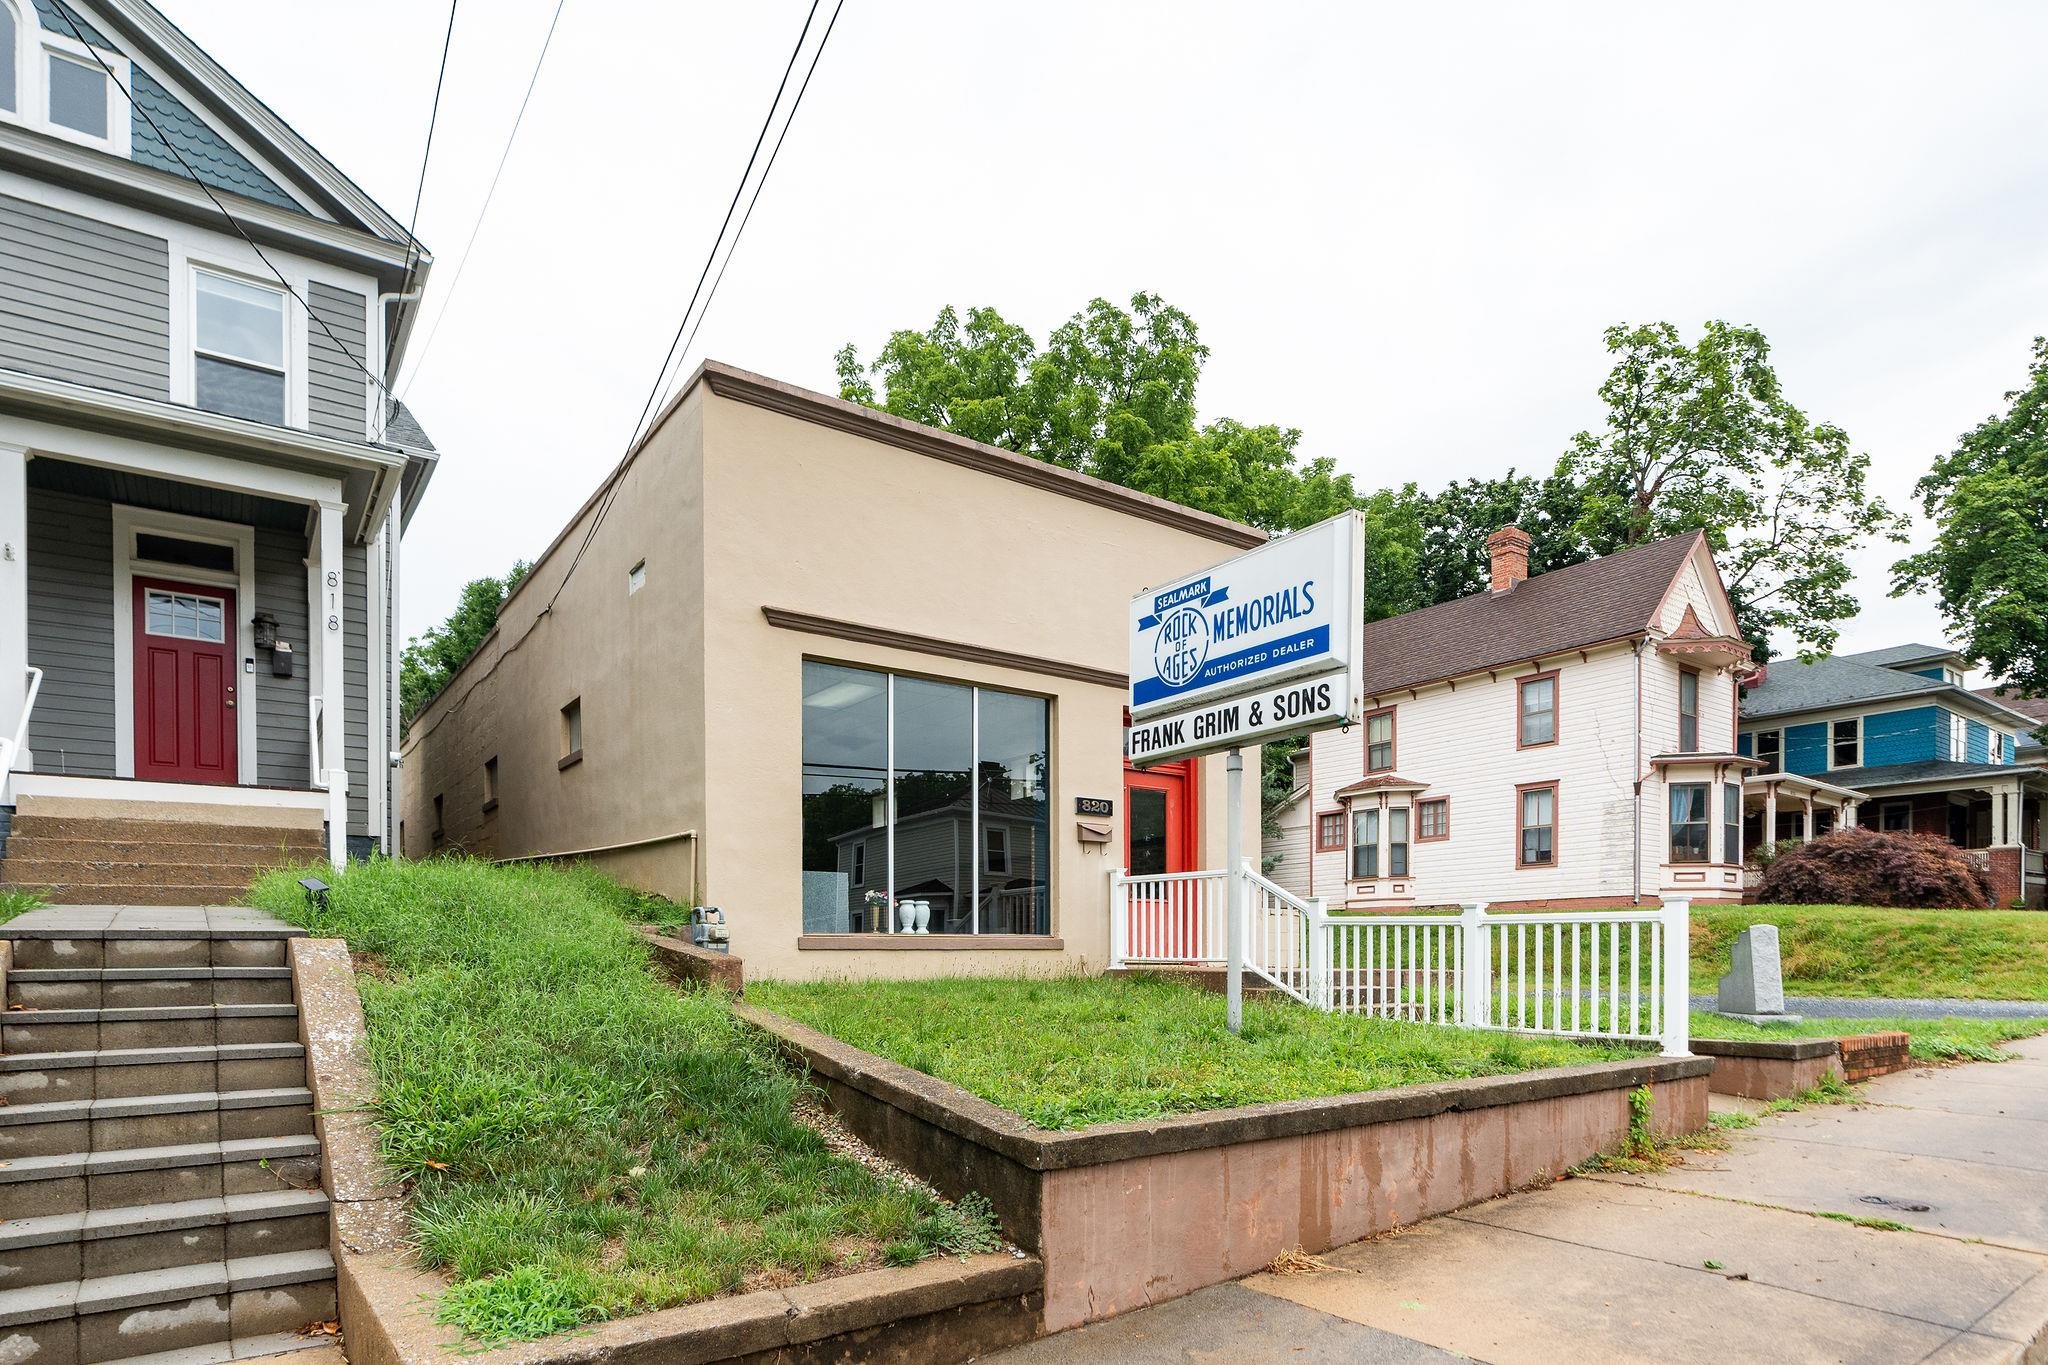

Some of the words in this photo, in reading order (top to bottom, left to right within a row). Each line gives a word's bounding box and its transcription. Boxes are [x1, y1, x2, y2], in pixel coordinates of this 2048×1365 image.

[327, 571, 339, 631] 818
[1157, 580, 1208, 610] SEALMARK
[1164, 612, 1198, 645] ROCK
[1213, 580, 1315, 644] MEMORIALS
[1175, 640, 1186, 652] OF
[1204, 652, 1267, 678] AUTHORIZED
[1273, 638, 1315, 658] DEALER
[1162, 648, 1197, 681] AGES
[1132, 720, 1185, 755] FRANK
[1193, 705, 1240, 740] GRIM
[1248, 700, 1264, 727] &
[1273, 683, 1331, 722] SONS
[1082, 800, 1109, 813] 820
